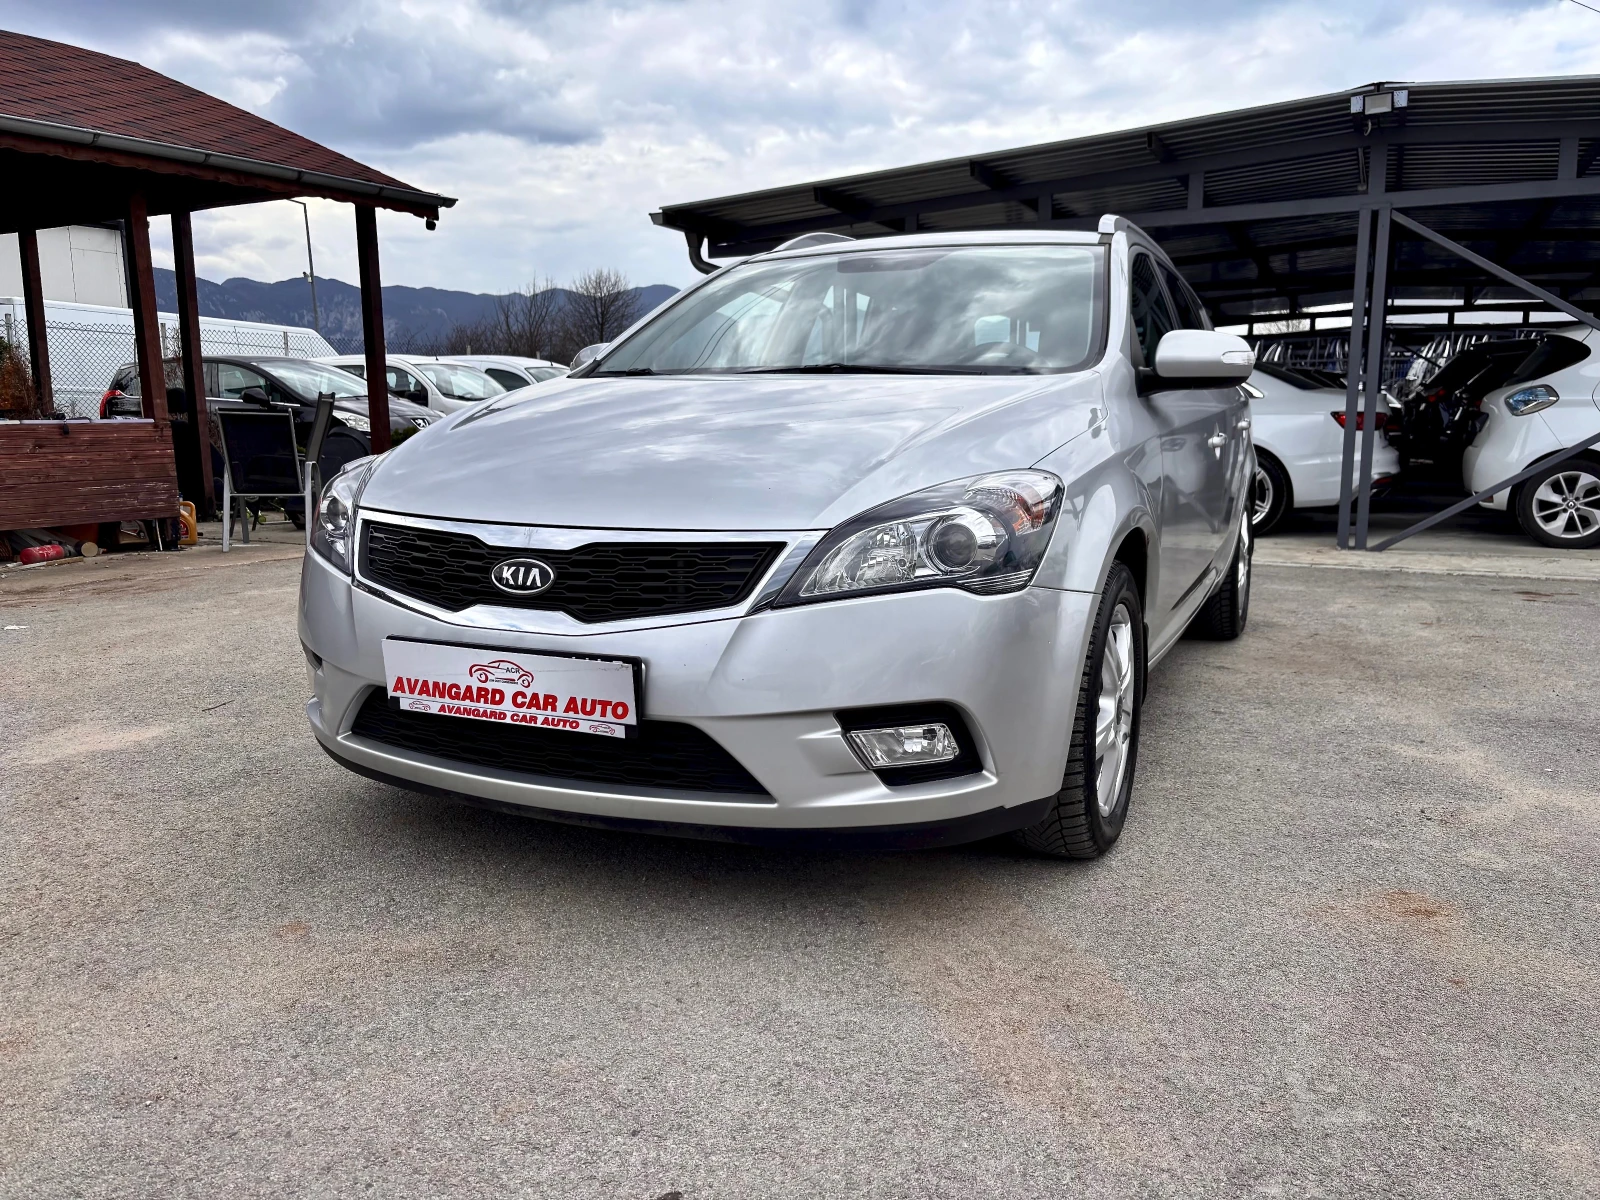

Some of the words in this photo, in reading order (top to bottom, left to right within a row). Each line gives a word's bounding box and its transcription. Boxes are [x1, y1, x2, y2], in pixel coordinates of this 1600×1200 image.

[502, 566, 541, 587] KIA
[393, 676, 505, 706] AVANGARD
[511, 690, 558, 713] CAR
[563, 696, 629, 720] AUTO
[438, 704, 507, 721] AVANGARD
[511, 713, 538, 725] CAR
[541, 717, 580, 729] AUTO
